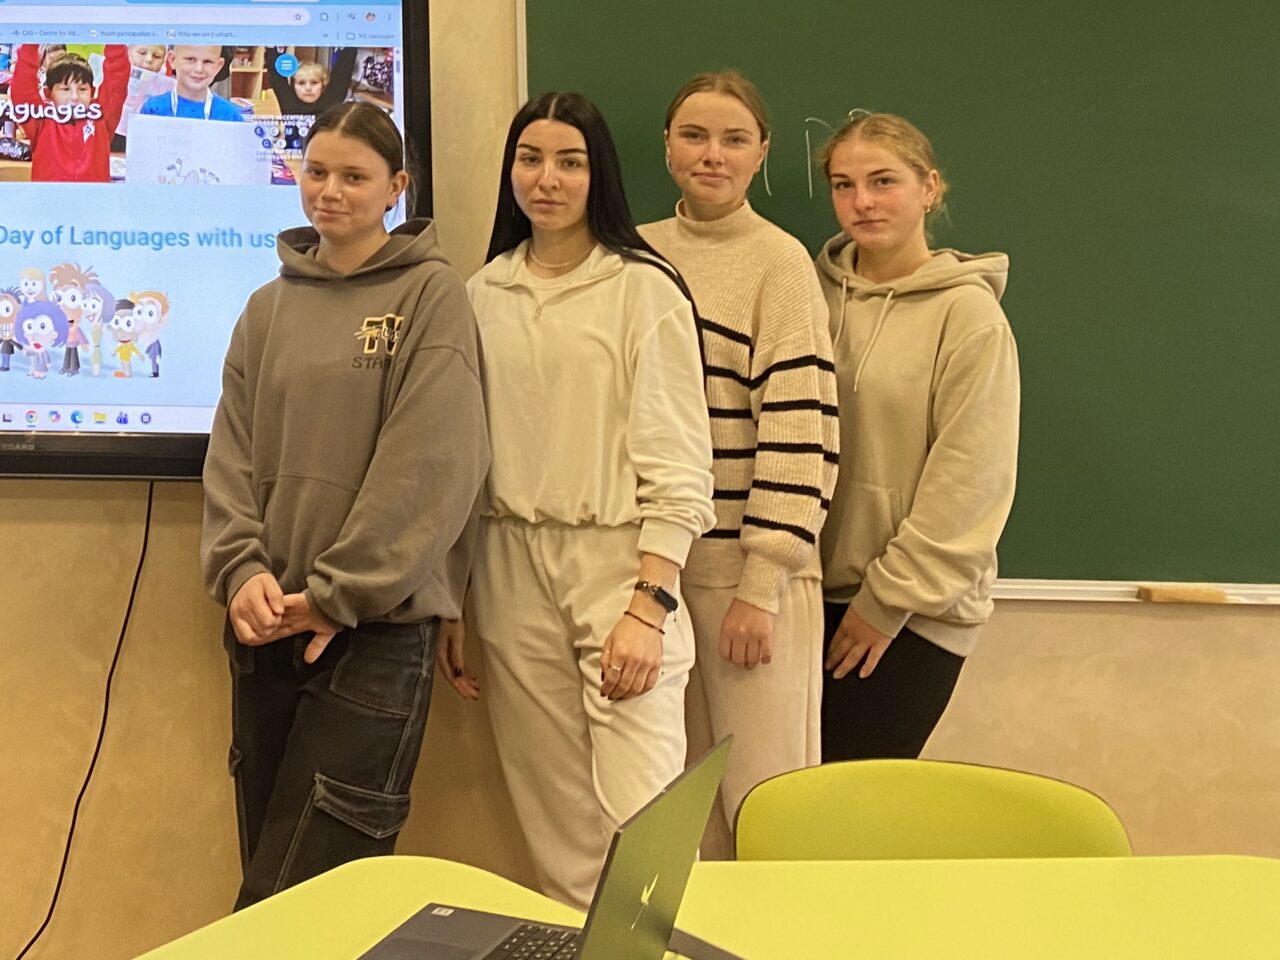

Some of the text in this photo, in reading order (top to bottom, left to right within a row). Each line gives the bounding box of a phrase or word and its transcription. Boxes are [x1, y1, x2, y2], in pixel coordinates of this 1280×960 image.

[41, 225, 64, 245] of
[70, 225, 190, 251] Languages
[196, 227, 243, 247] with
